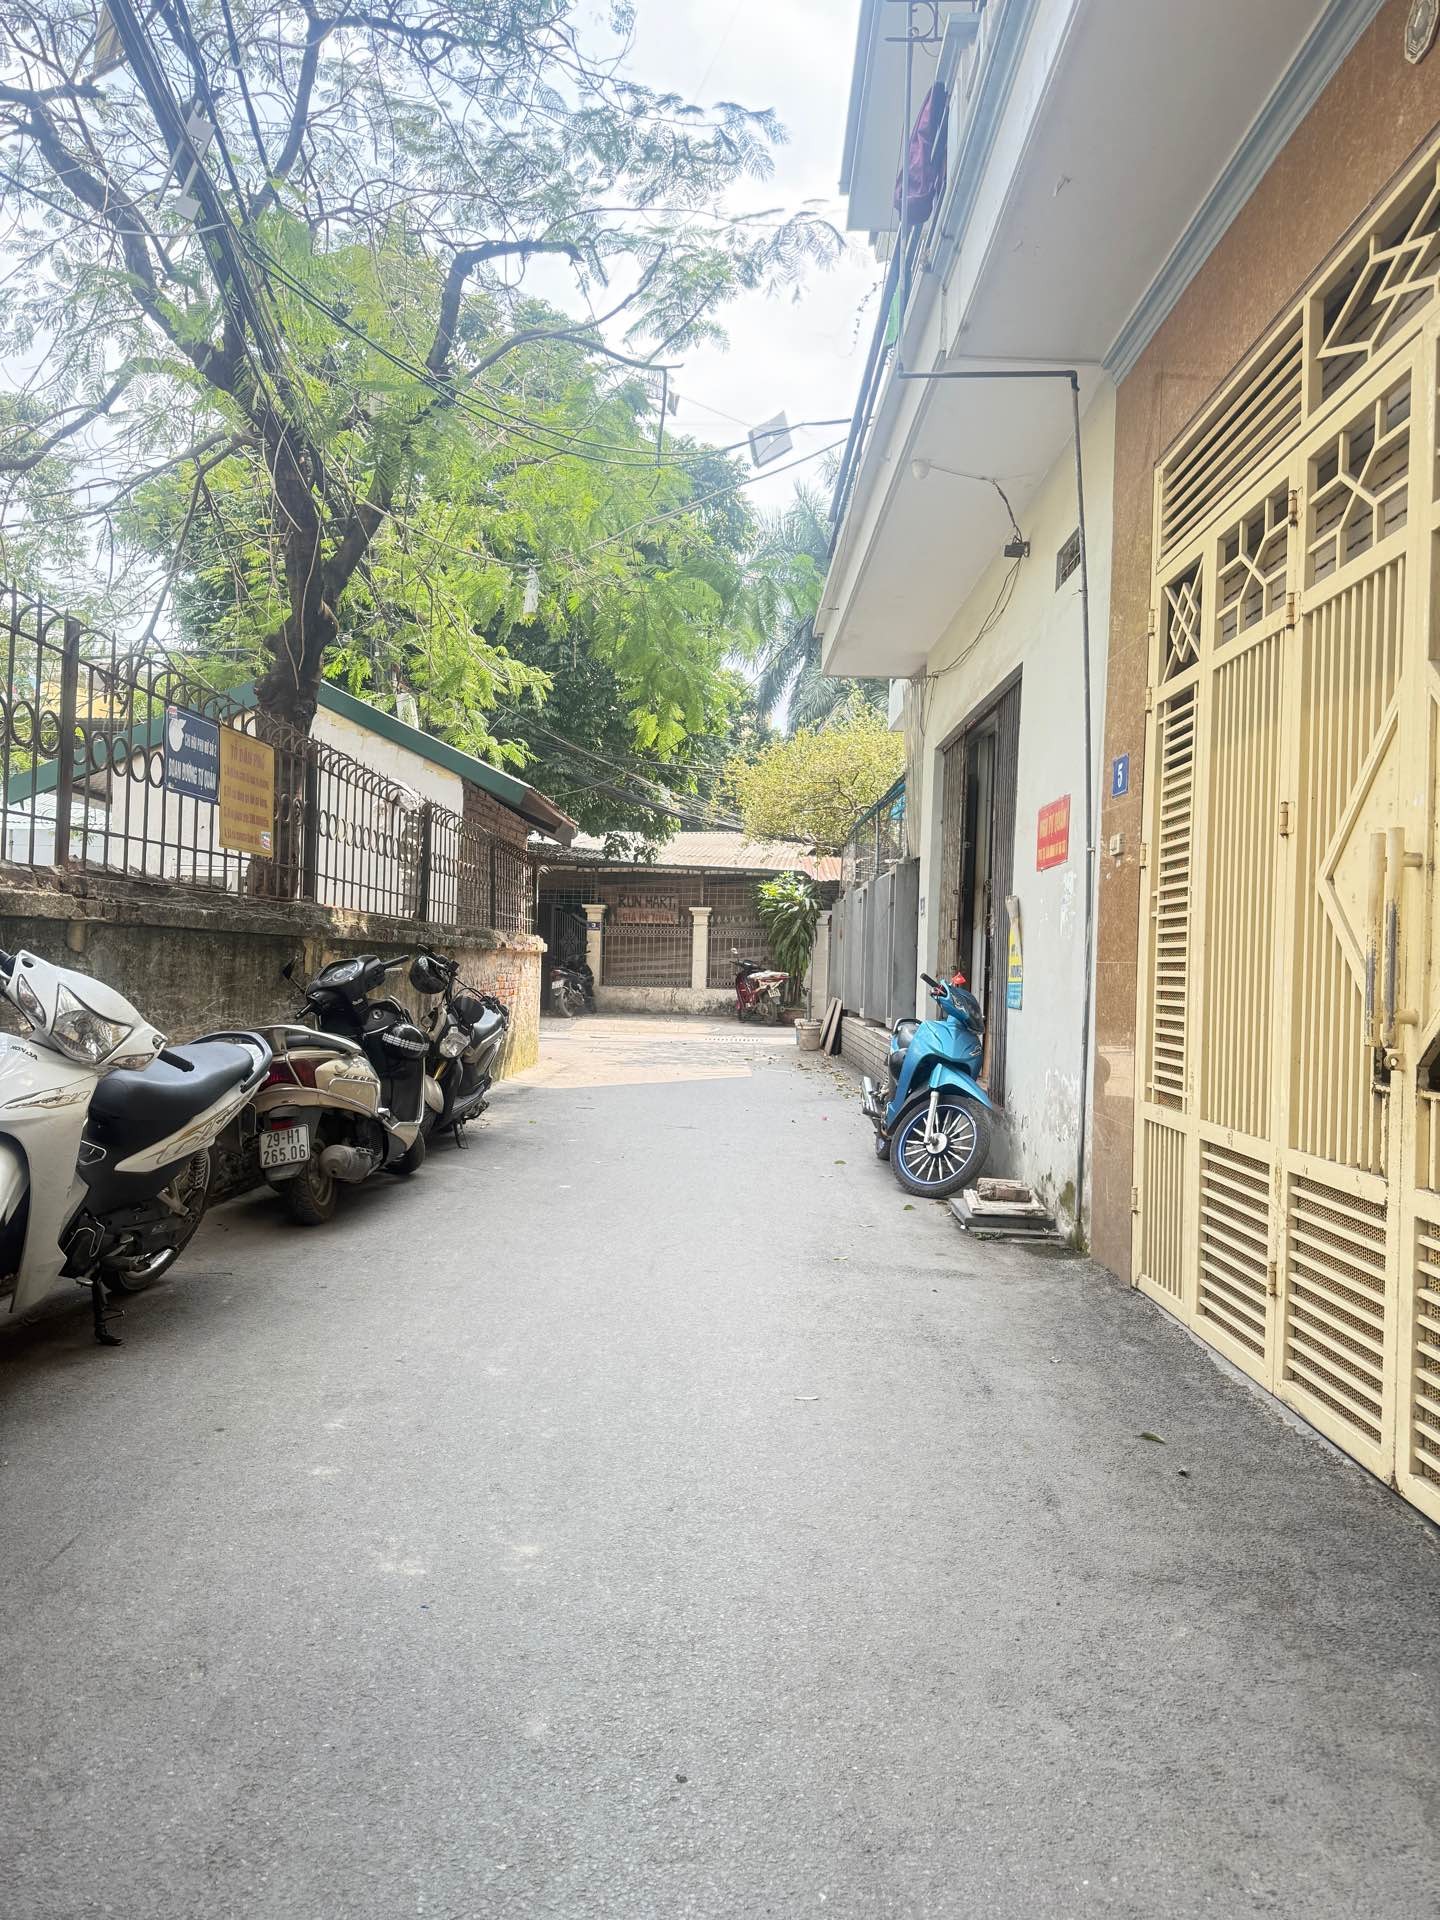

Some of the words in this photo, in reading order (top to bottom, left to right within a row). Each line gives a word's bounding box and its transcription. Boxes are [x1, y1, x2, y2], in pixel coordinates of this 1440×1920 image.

[1118, 762, 1124, 788] 5
[266, 1129, 300, 1148] 29-H1
[263, 1144, 306, 1165] 265.06
